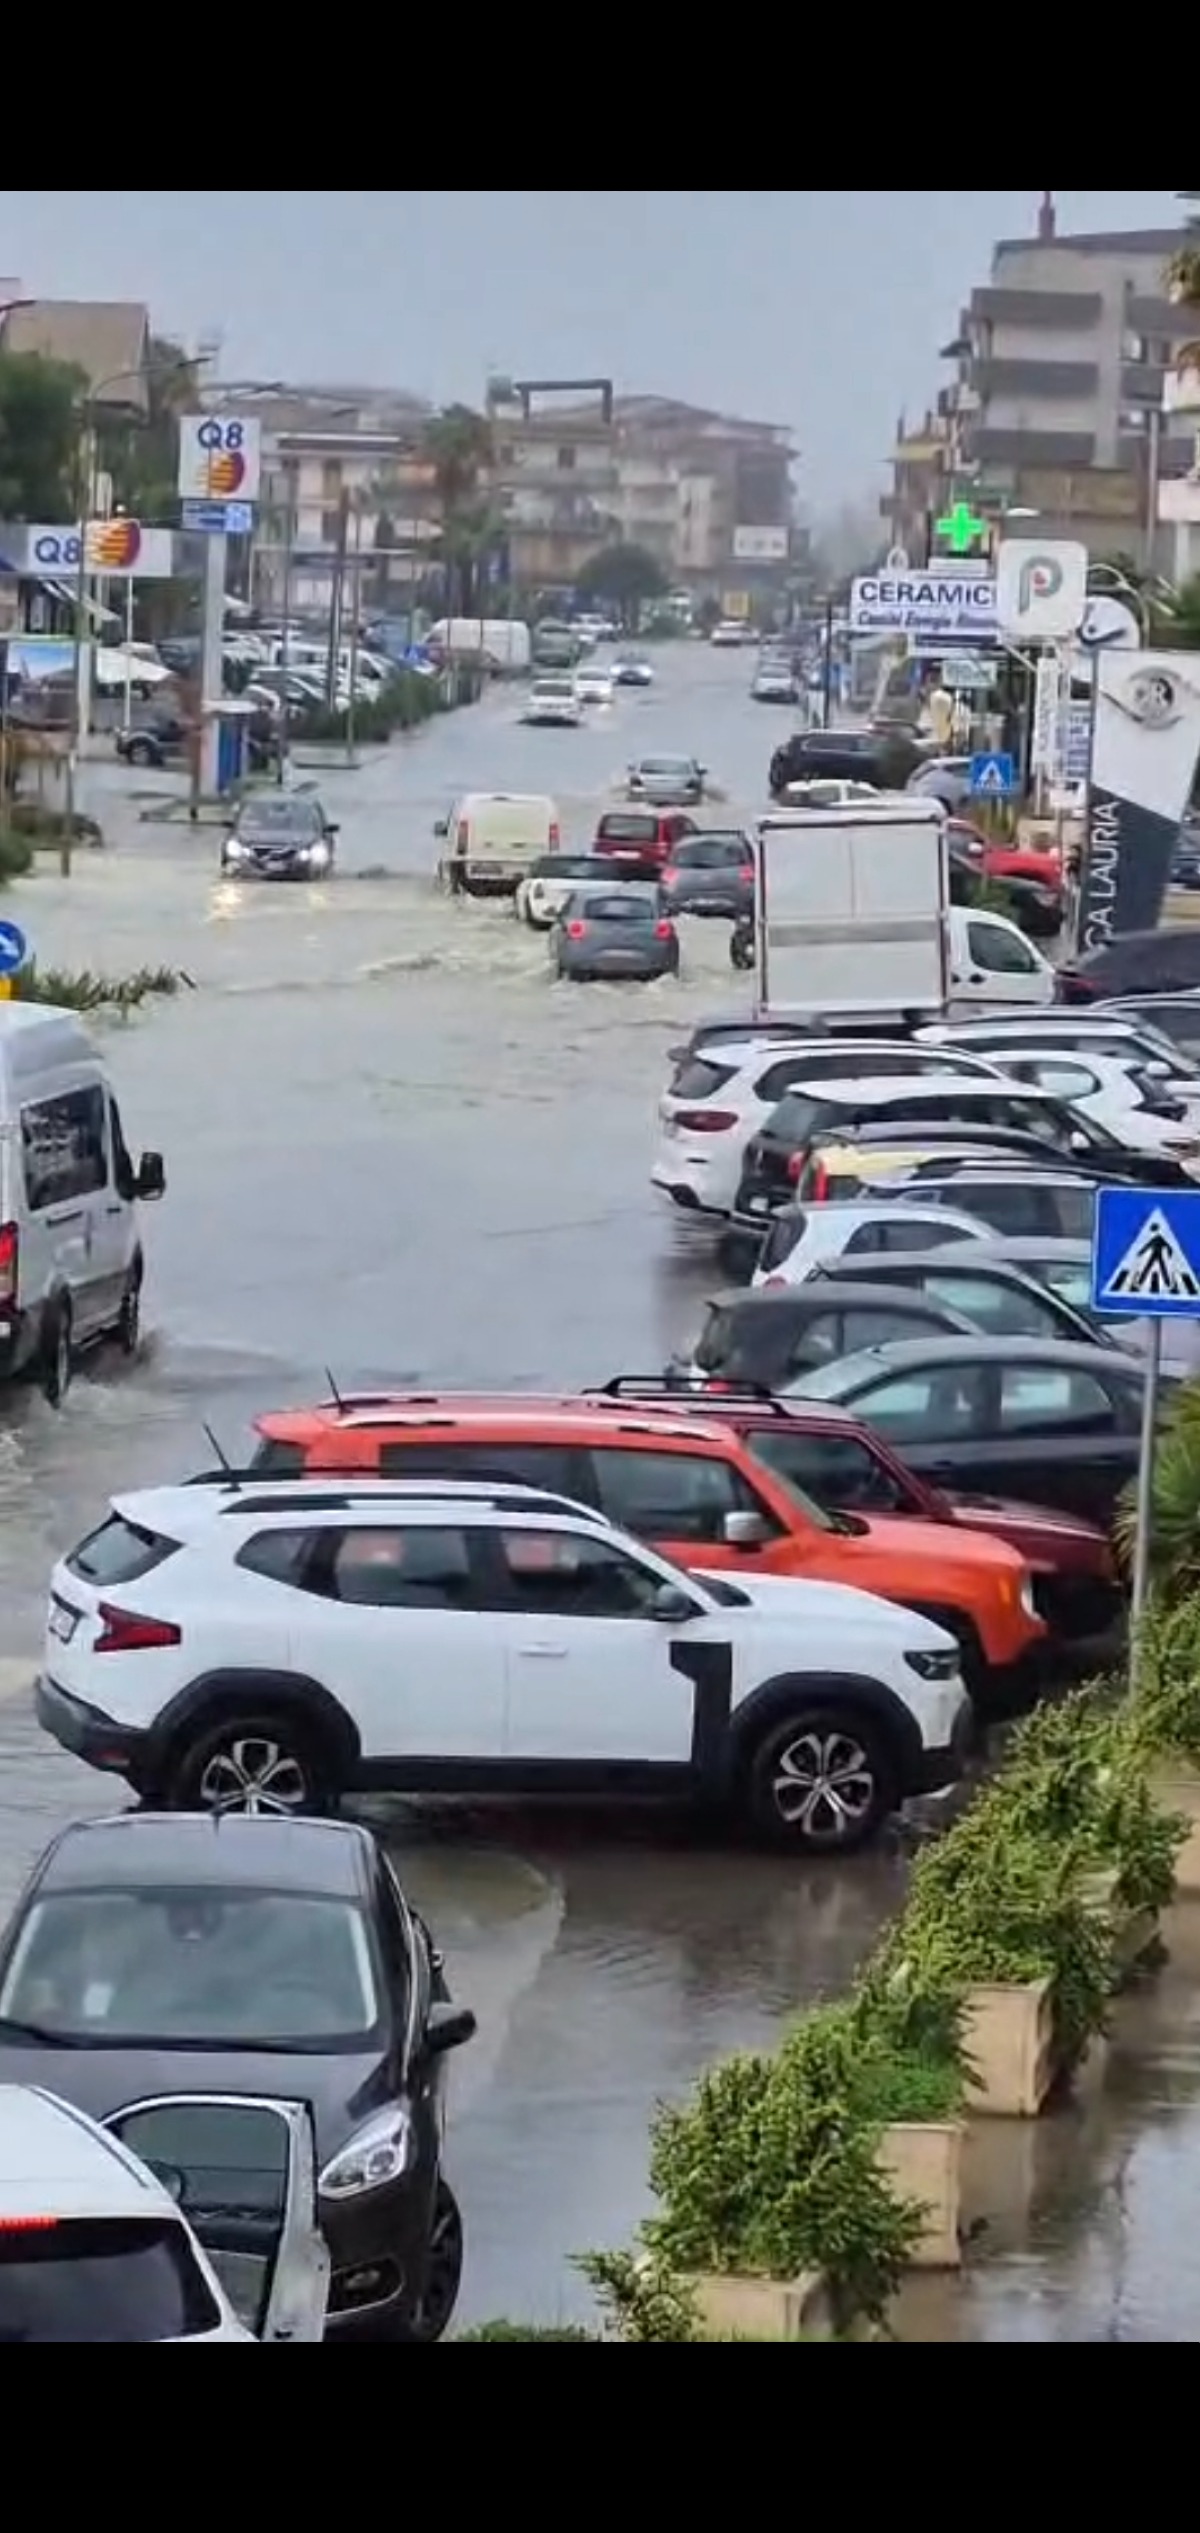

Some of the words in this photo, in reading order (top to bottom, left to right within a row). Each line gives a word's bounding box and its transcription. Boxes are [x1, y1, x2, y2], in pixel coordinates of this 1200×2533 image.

[197, 420, 244, 450] Q8
[34, 535, 82, 565] Q8
[1088, 801, 1121, 897] LAURIA
